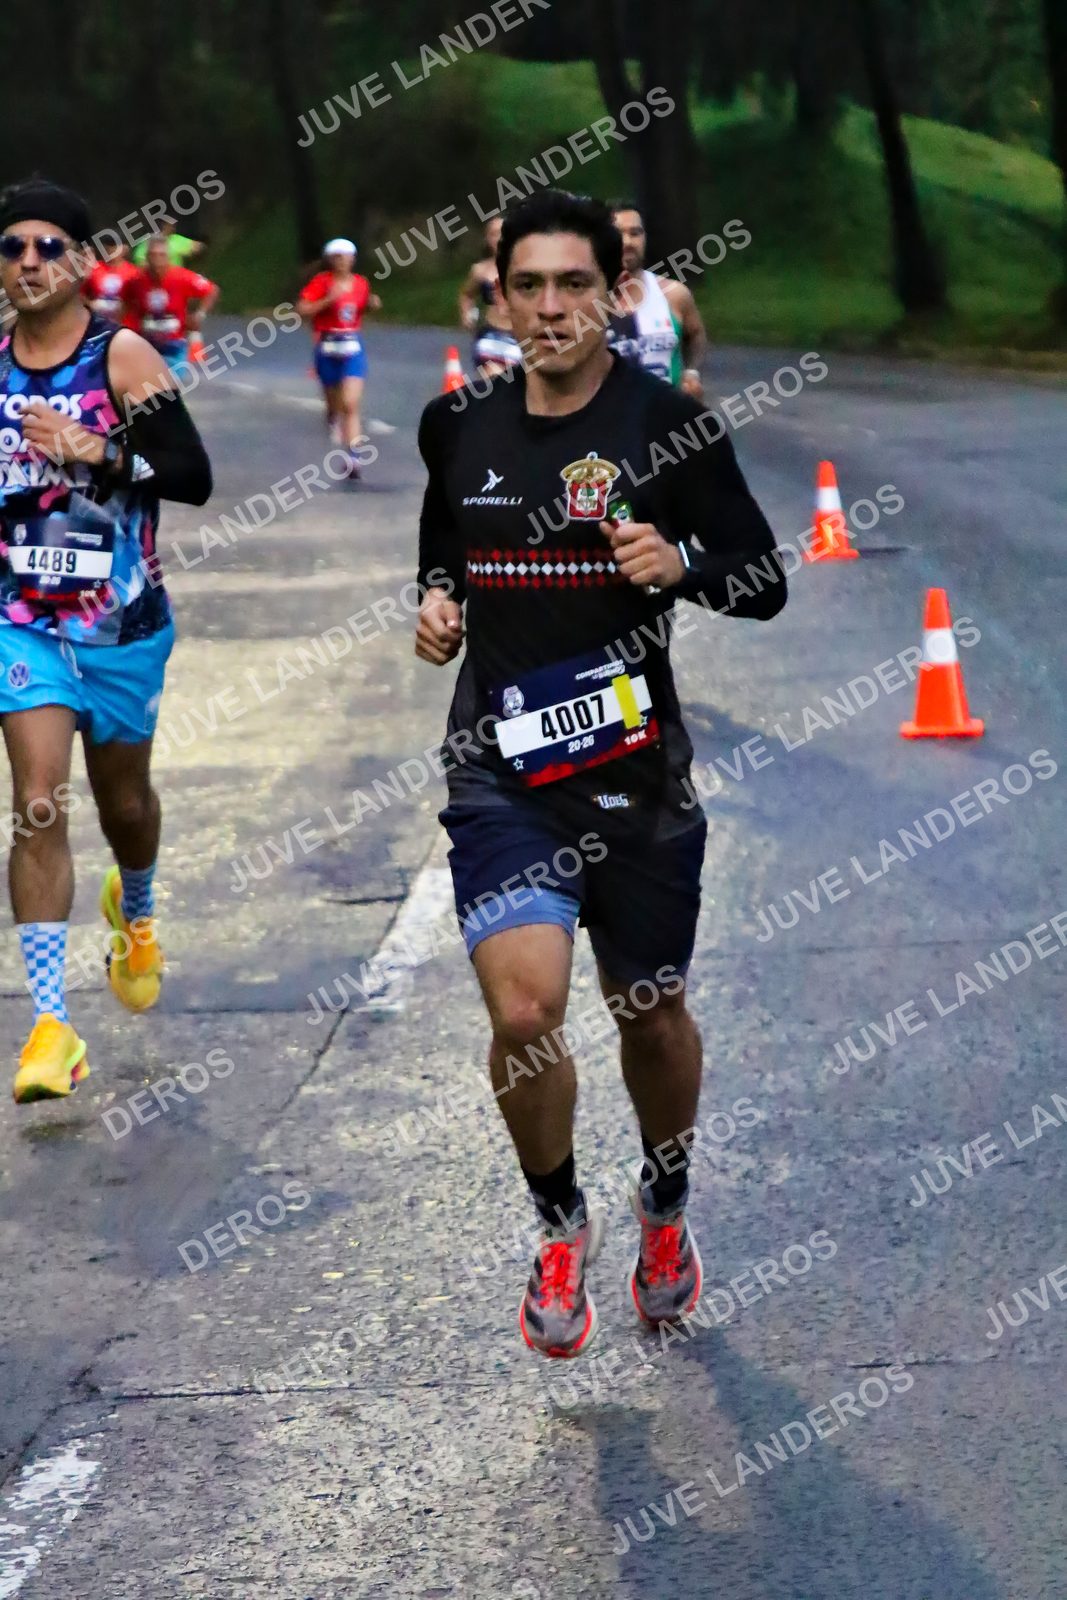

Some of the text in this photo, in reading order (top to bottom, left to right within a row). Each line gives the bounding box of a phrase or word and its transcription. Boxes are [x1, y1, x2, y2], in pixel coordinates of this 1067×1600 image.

[462, 496, 523, 506] SPORELLI
[27, 548, 77, 573] 4489
[541, 694, 605, 740] 4007
